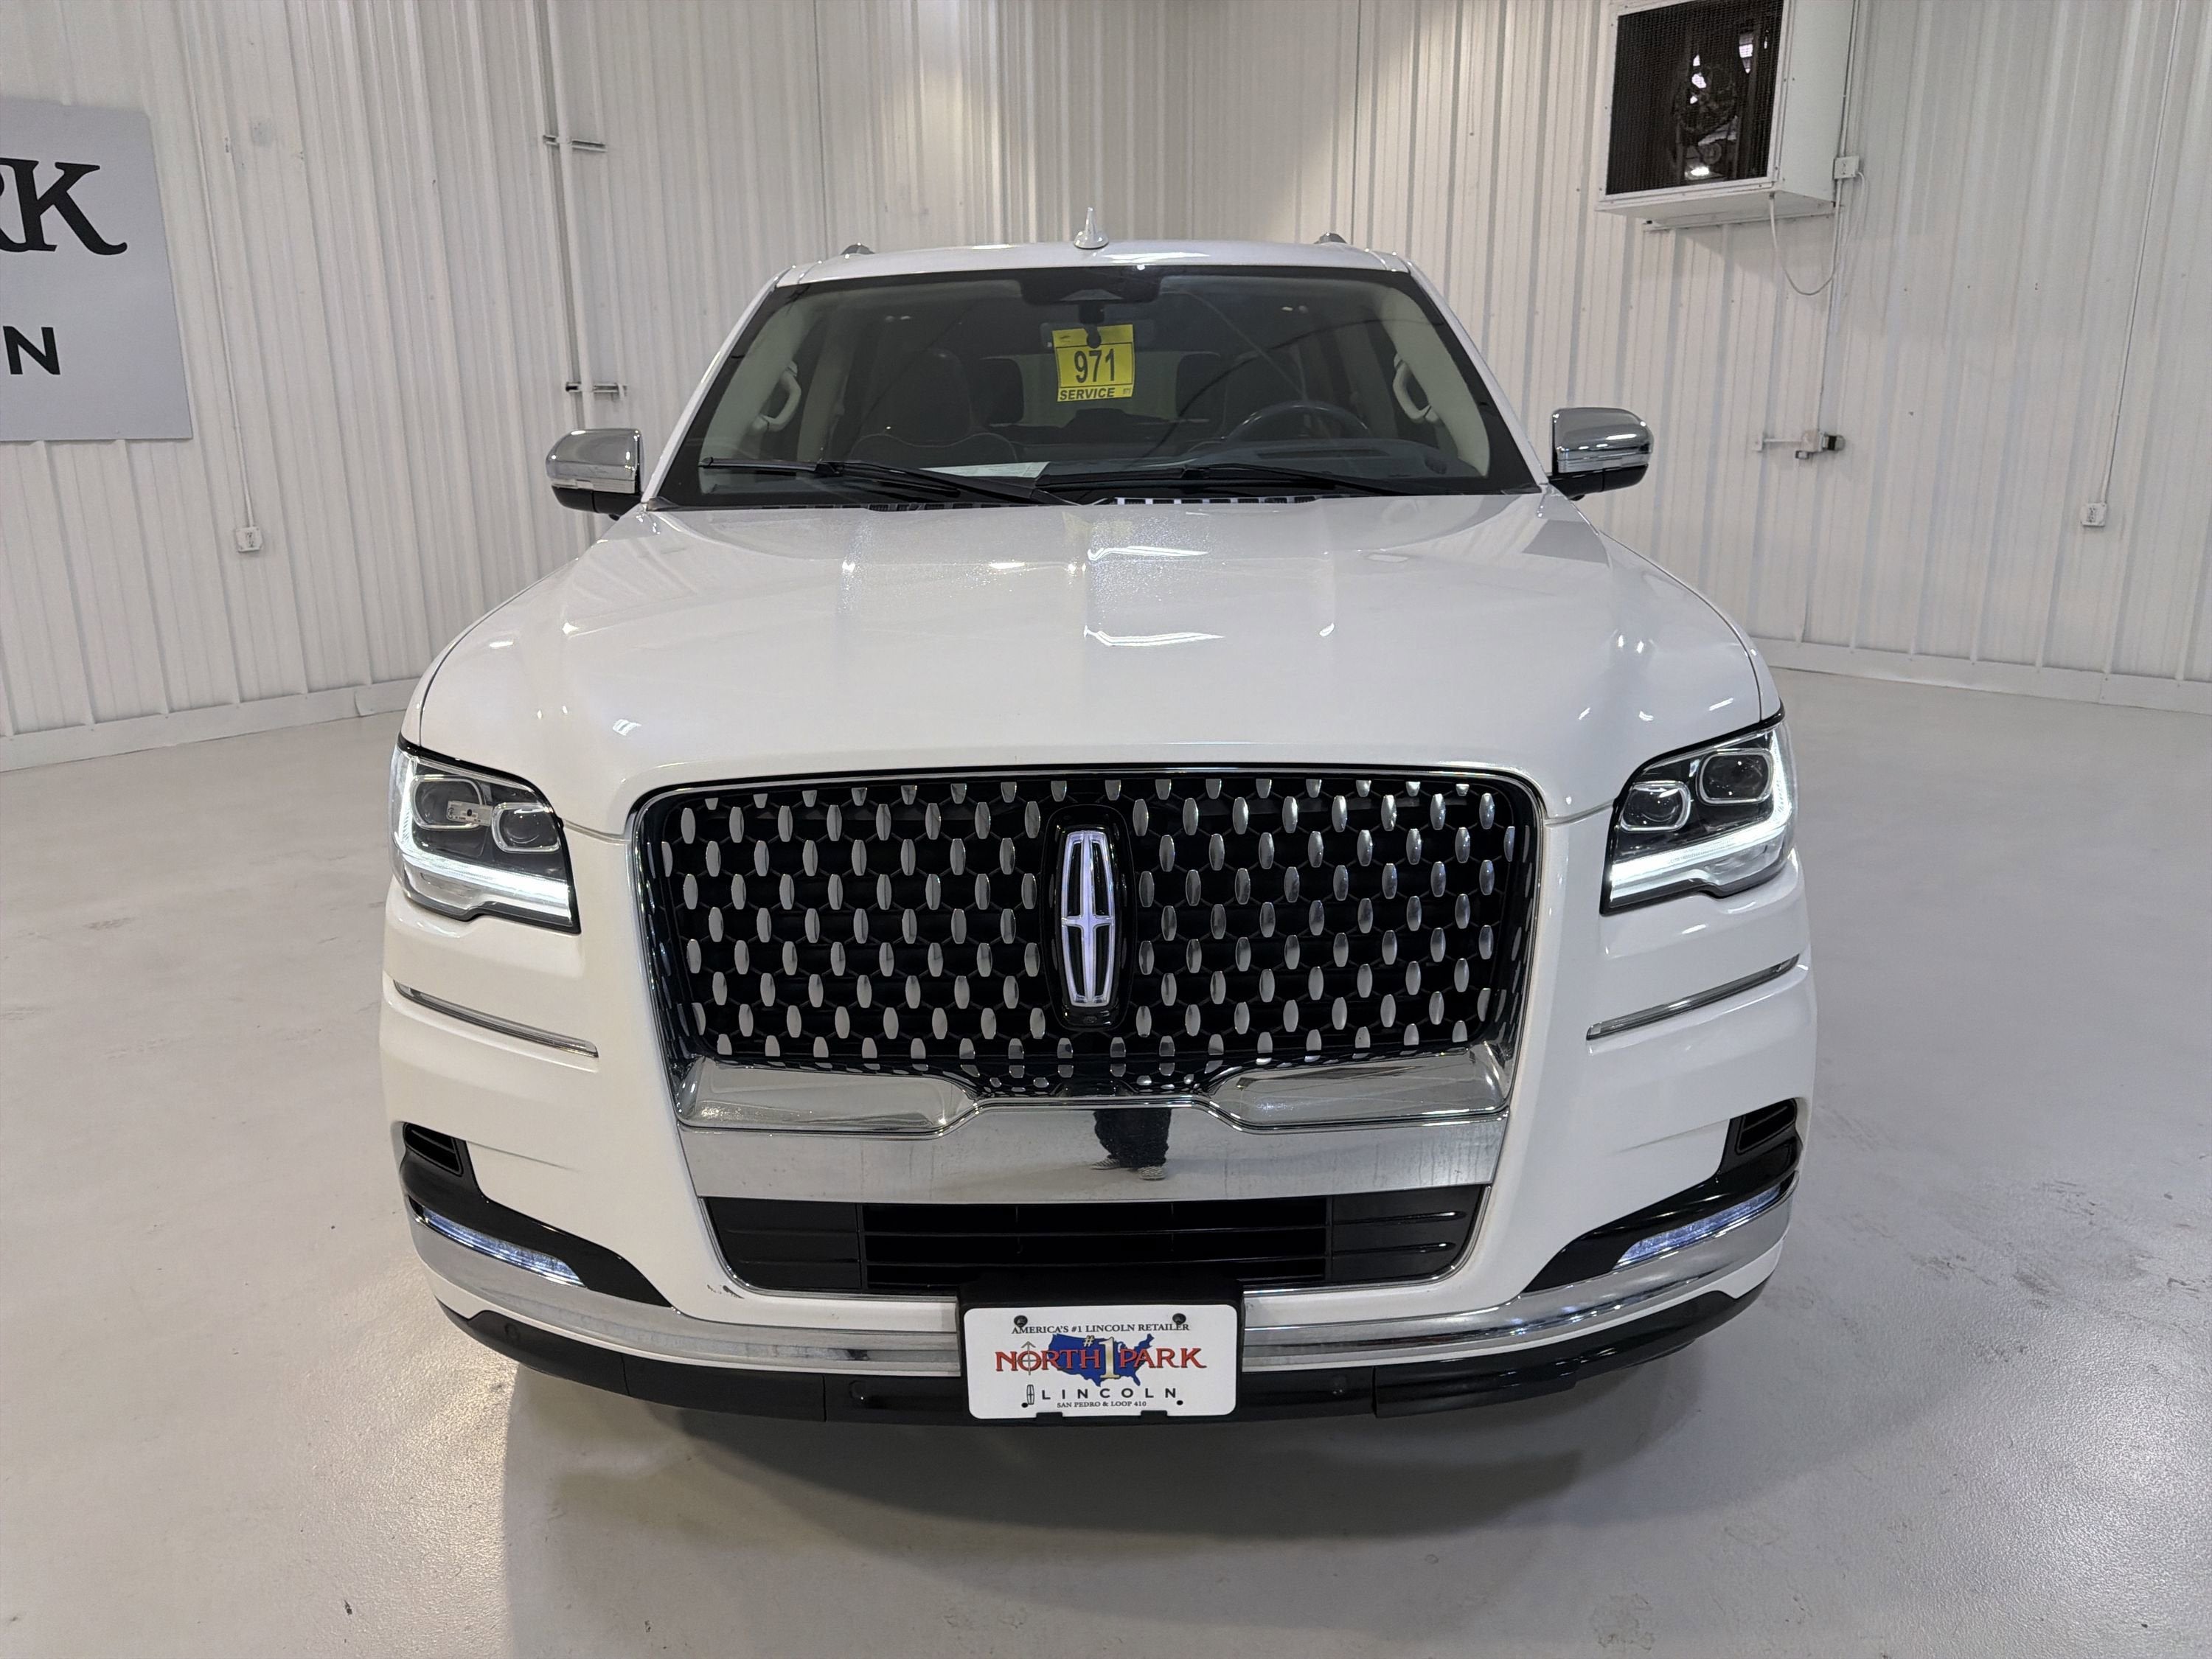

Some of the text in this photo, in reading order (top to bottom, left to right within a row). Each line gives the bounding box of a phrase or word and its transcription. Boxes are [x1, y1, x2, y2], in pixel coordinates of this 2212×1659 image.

[1074, 348, 1115, 383] 971
[1060, 387, 1116, 400] SERVICE
[1012, 1325, 1068, 1335] AMERICA'S
[1085, 1324, 1135, 1333] LINCOLN
[1138, 1323, 1189, 1332] RETAILER
[995, 1347, 1208, 1371] NORTH PARK
[1041, 1388, 1177, 1400] LINCOLN
